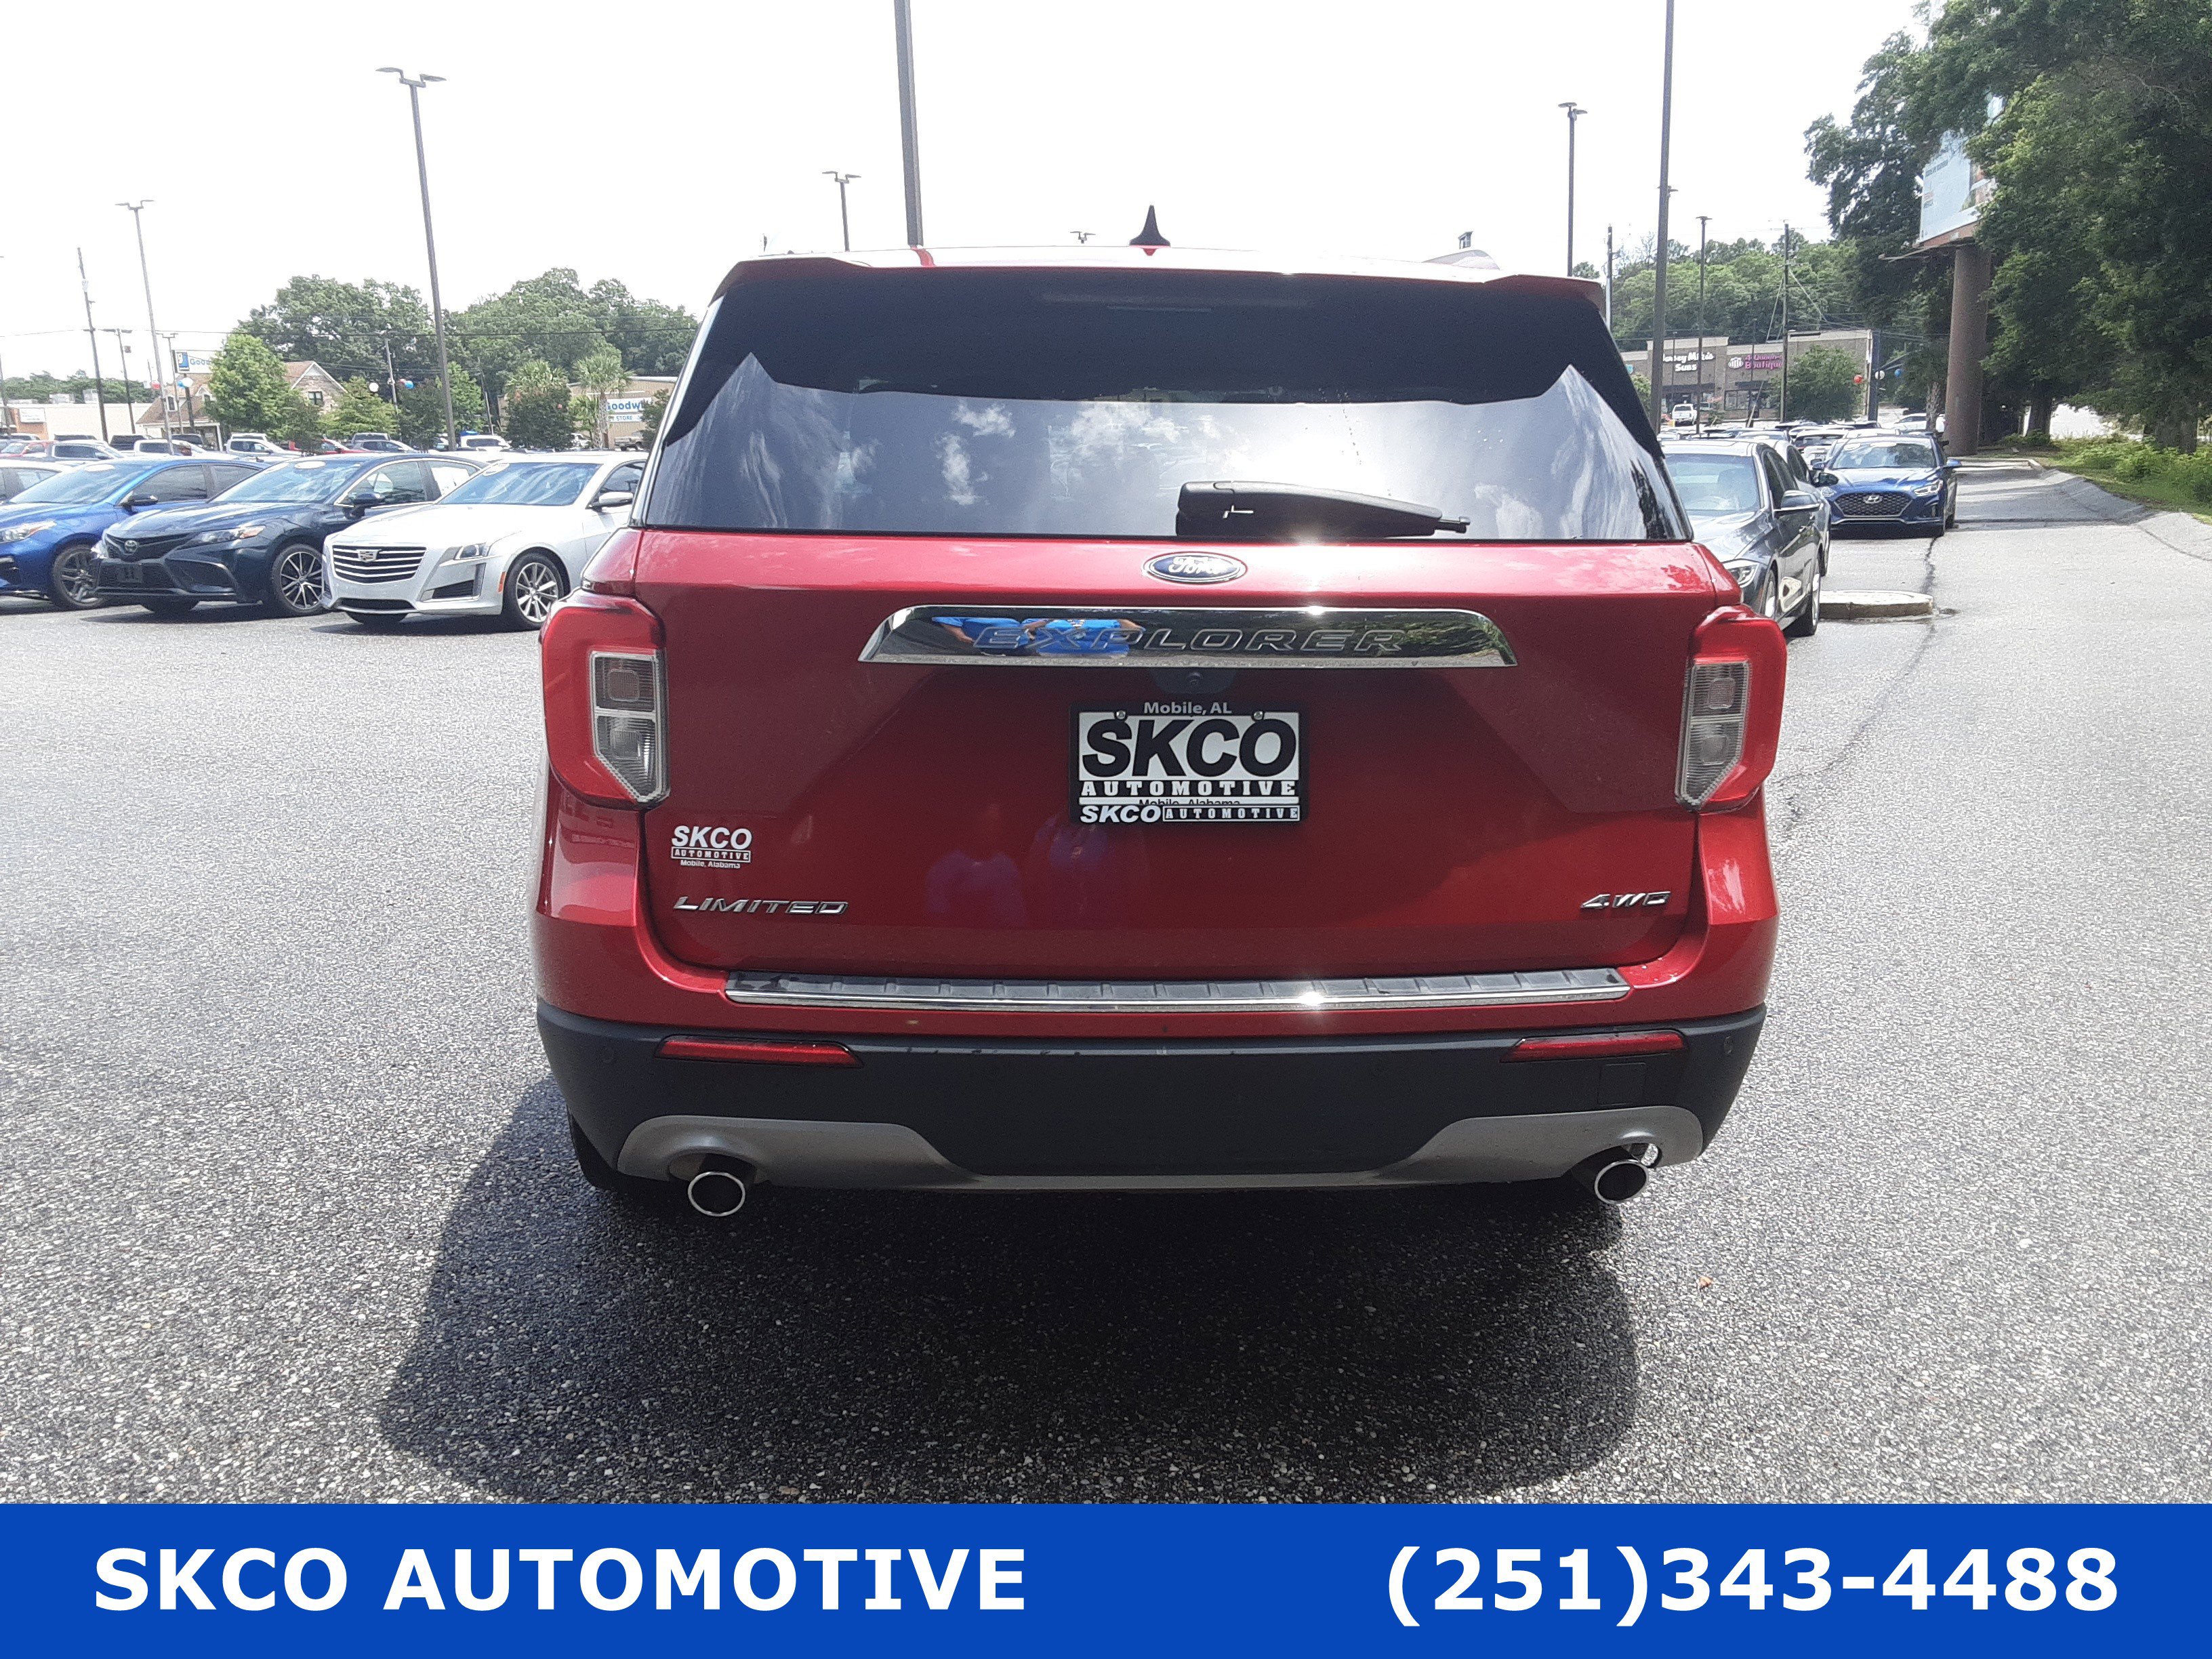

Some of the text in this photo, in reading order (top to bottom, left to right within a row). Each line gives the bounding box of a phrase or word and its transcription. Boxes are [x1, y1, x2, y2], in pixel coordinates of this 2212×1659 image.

[972, 626, 1406, 652] EXPLORER
[1143, 701, 1232, 716] Mobile, AL
[1082, 718, 1296, 777] SKCO
[1081, 781, 1296, 796] AUTOMOTIVE
[1080, 805, 1298, 823] SKCO AUTOMOTIVE
[672, 825, 752, 850] SKCO
[674, 848, 749, 861] AUTOMOTIVE
[708, 861, 741, 869] Alabama
[673, 896, 848, 914] LIMITED
[1580, 890, 1671, 909] 4WD
